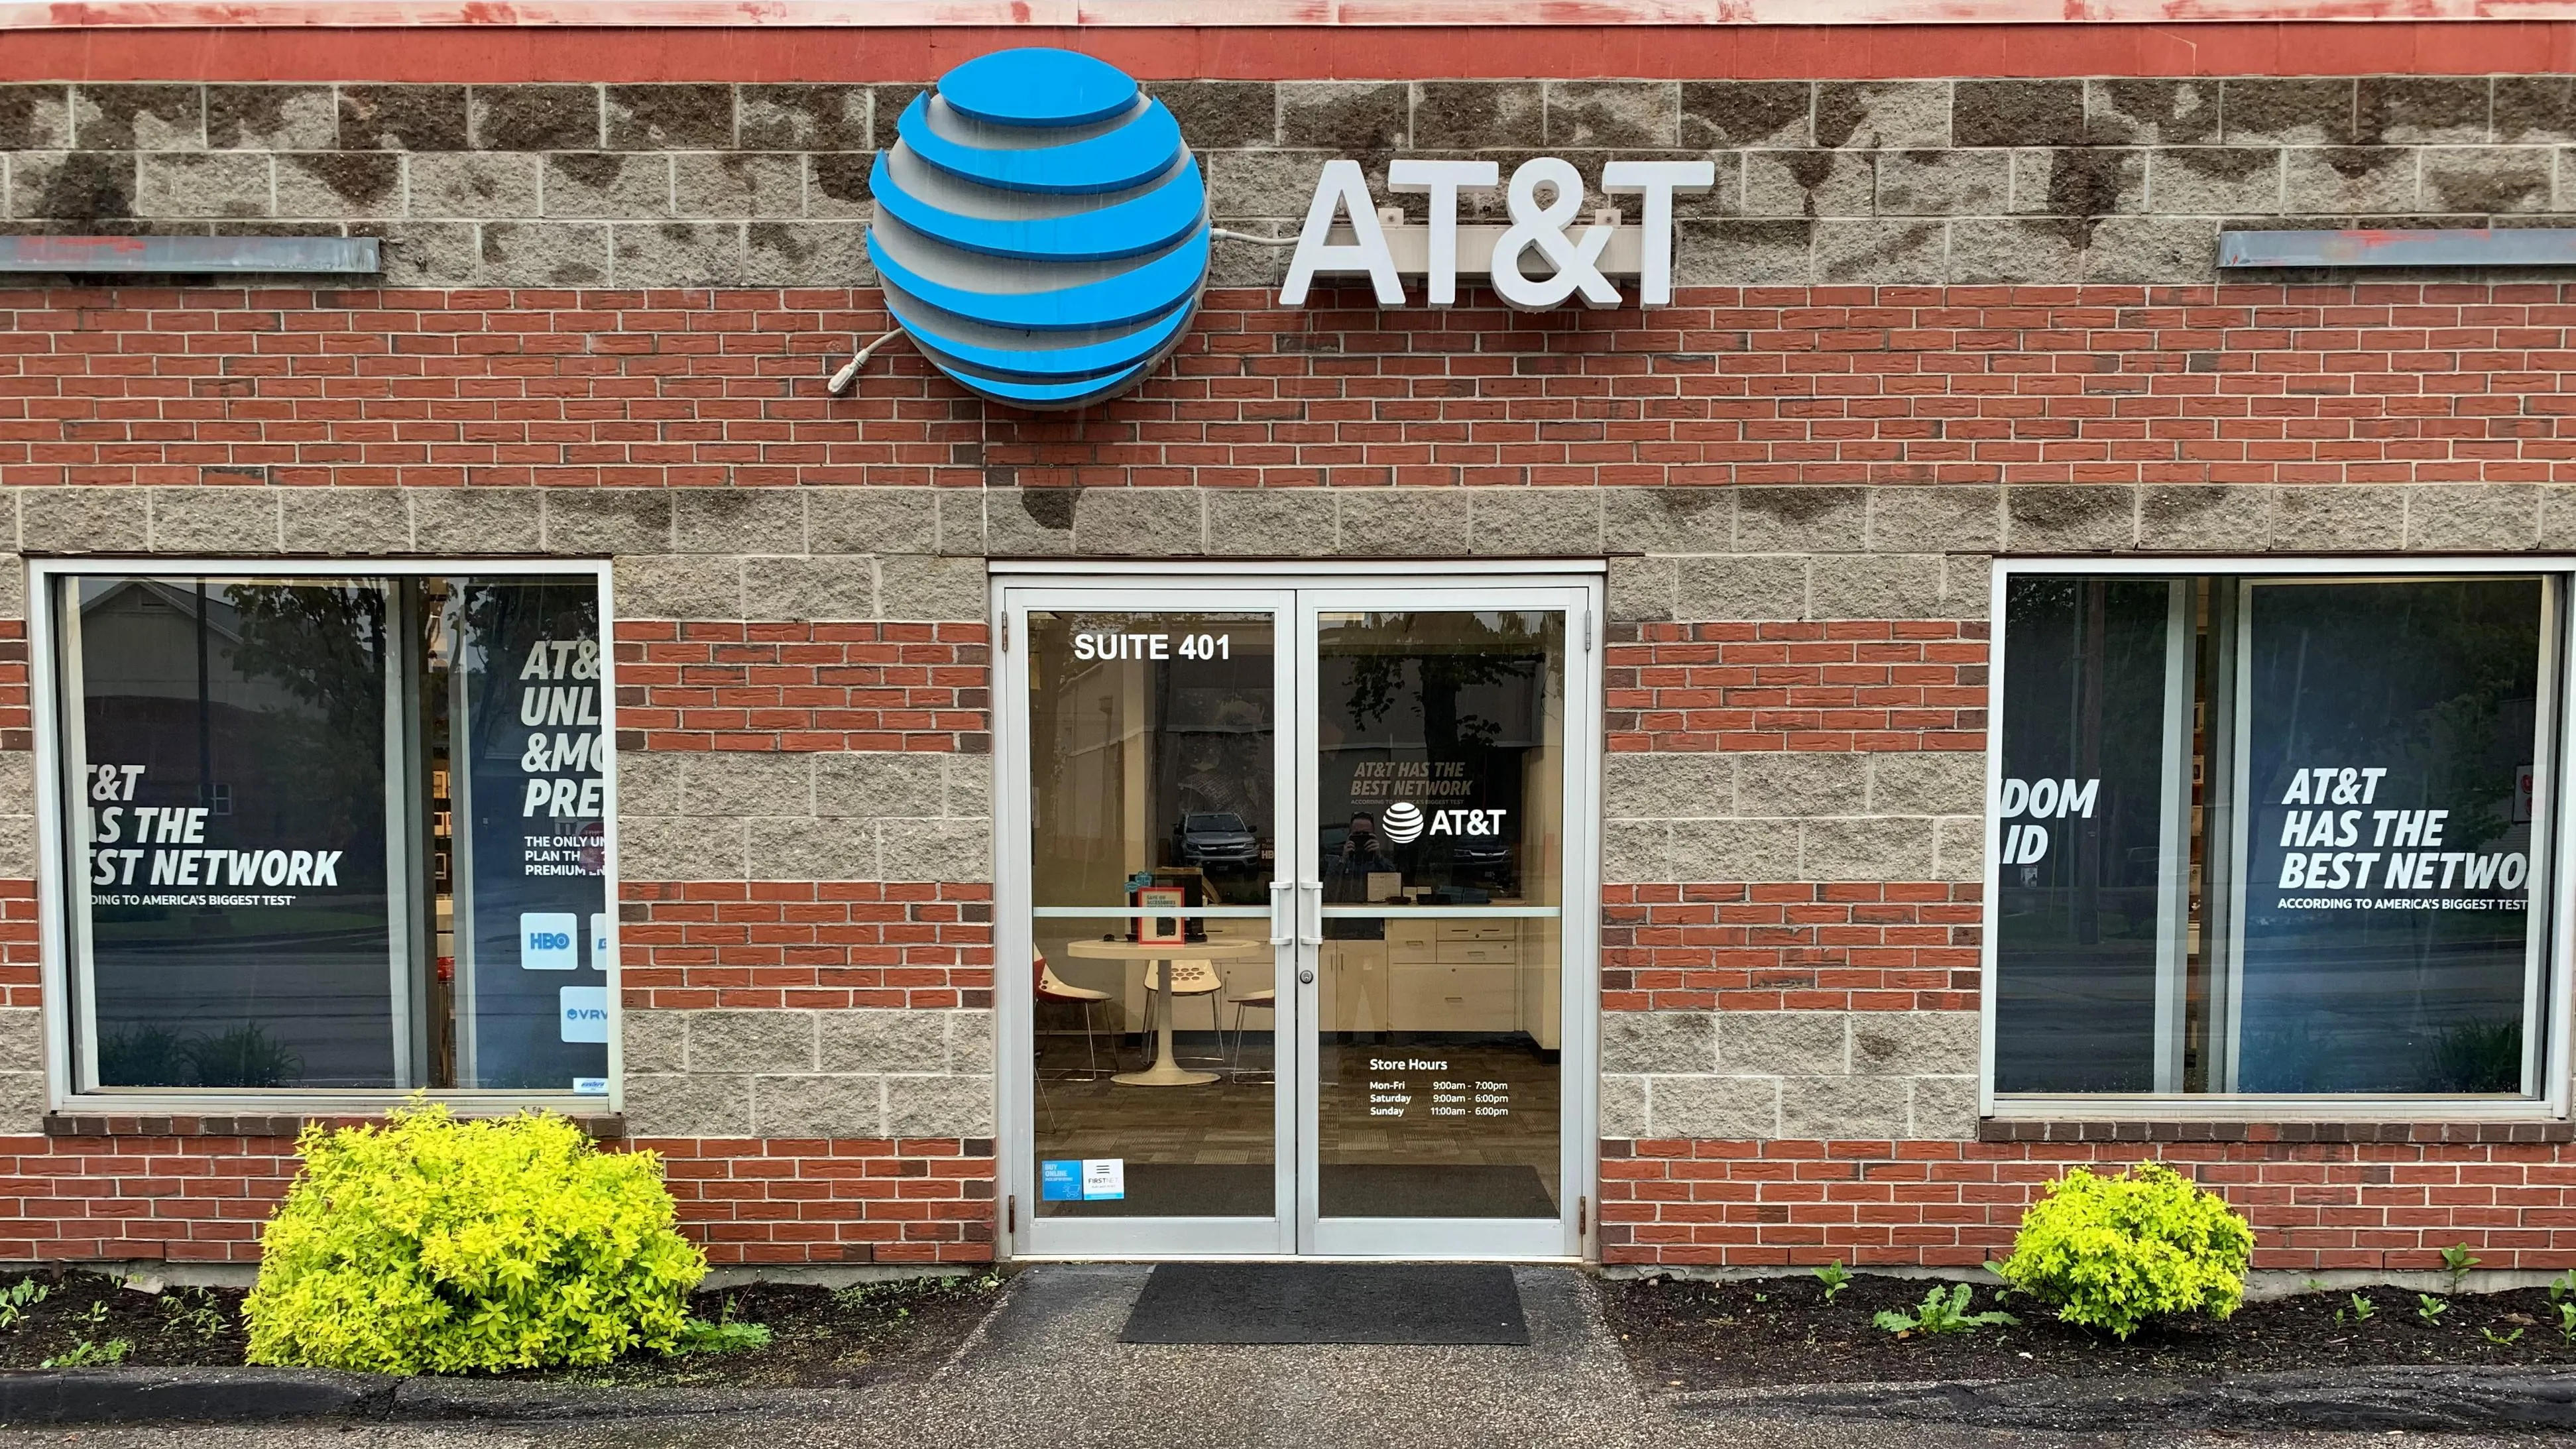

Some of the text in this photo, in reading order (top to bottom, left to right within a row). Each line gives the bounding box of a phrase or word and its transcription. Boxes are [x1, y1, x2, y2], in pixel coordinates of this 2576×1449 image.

[1279, 157, 1714, 312] AT&T
[1074, 634, 1229, 660] SUITE 401
[520, 686, 601, 726] UNL
[1354, 762, 1465, 778] AT&T HAS THE
[1350, 780, 1473, 796] BEST NETWORK
[2281, 767, 2388, 805] AT&T
[522, 778, 604, 817] PRE
[2001, 778, 2100, 819] DOM
[134, 807, 209, 844] THE
[1429, 809, 1507, 836] AT&T
[2280, 809, 2449, 847] HAS THE
[524, 836, 551, 847] THE
[553, 836, 587, 847] ONLY
[525, 850, 559, 862] PLAN
[150, 849, 343, 886] NETWORK
[525, 864, 586, 876] PREMIUM
[2278, 852, 2530, 890] BEST NETWO
[122, 895, 140, 905] TO
[142, 895, 207, 905] AMERICA'S
[209, 895, 261, 905] BIGGEST
[2277, 898, 2352, 910] ACCORDING
[2354, 898, 2371, 910] TO
[2374, 898, 2439, 910] AMERICA'S
[2441, 899, 2494, 910] BIGGEST
[530, 933, 570, 950] HBO
[1370, 1059, 1448, 1071] Store Hours
[1370, 1080, 1405, 1090] Mon-Fri
[1433, 1081, 1466, 1090] 9:00am
[1475, 1081, 1508, 1092] 7:00pm
[1370, 1094, 1411, 1104] Saturday
[1433, 1094, 1466, 1103] 9:00am
[1475, 1094, 1509, 1104] 6:00pm
[1370, 1106, 1404, 1117] Sunday
[1431, 1106, 1466, 1116] 11:00am
[1475, 1106, 1509, 1117] 6:00pm
